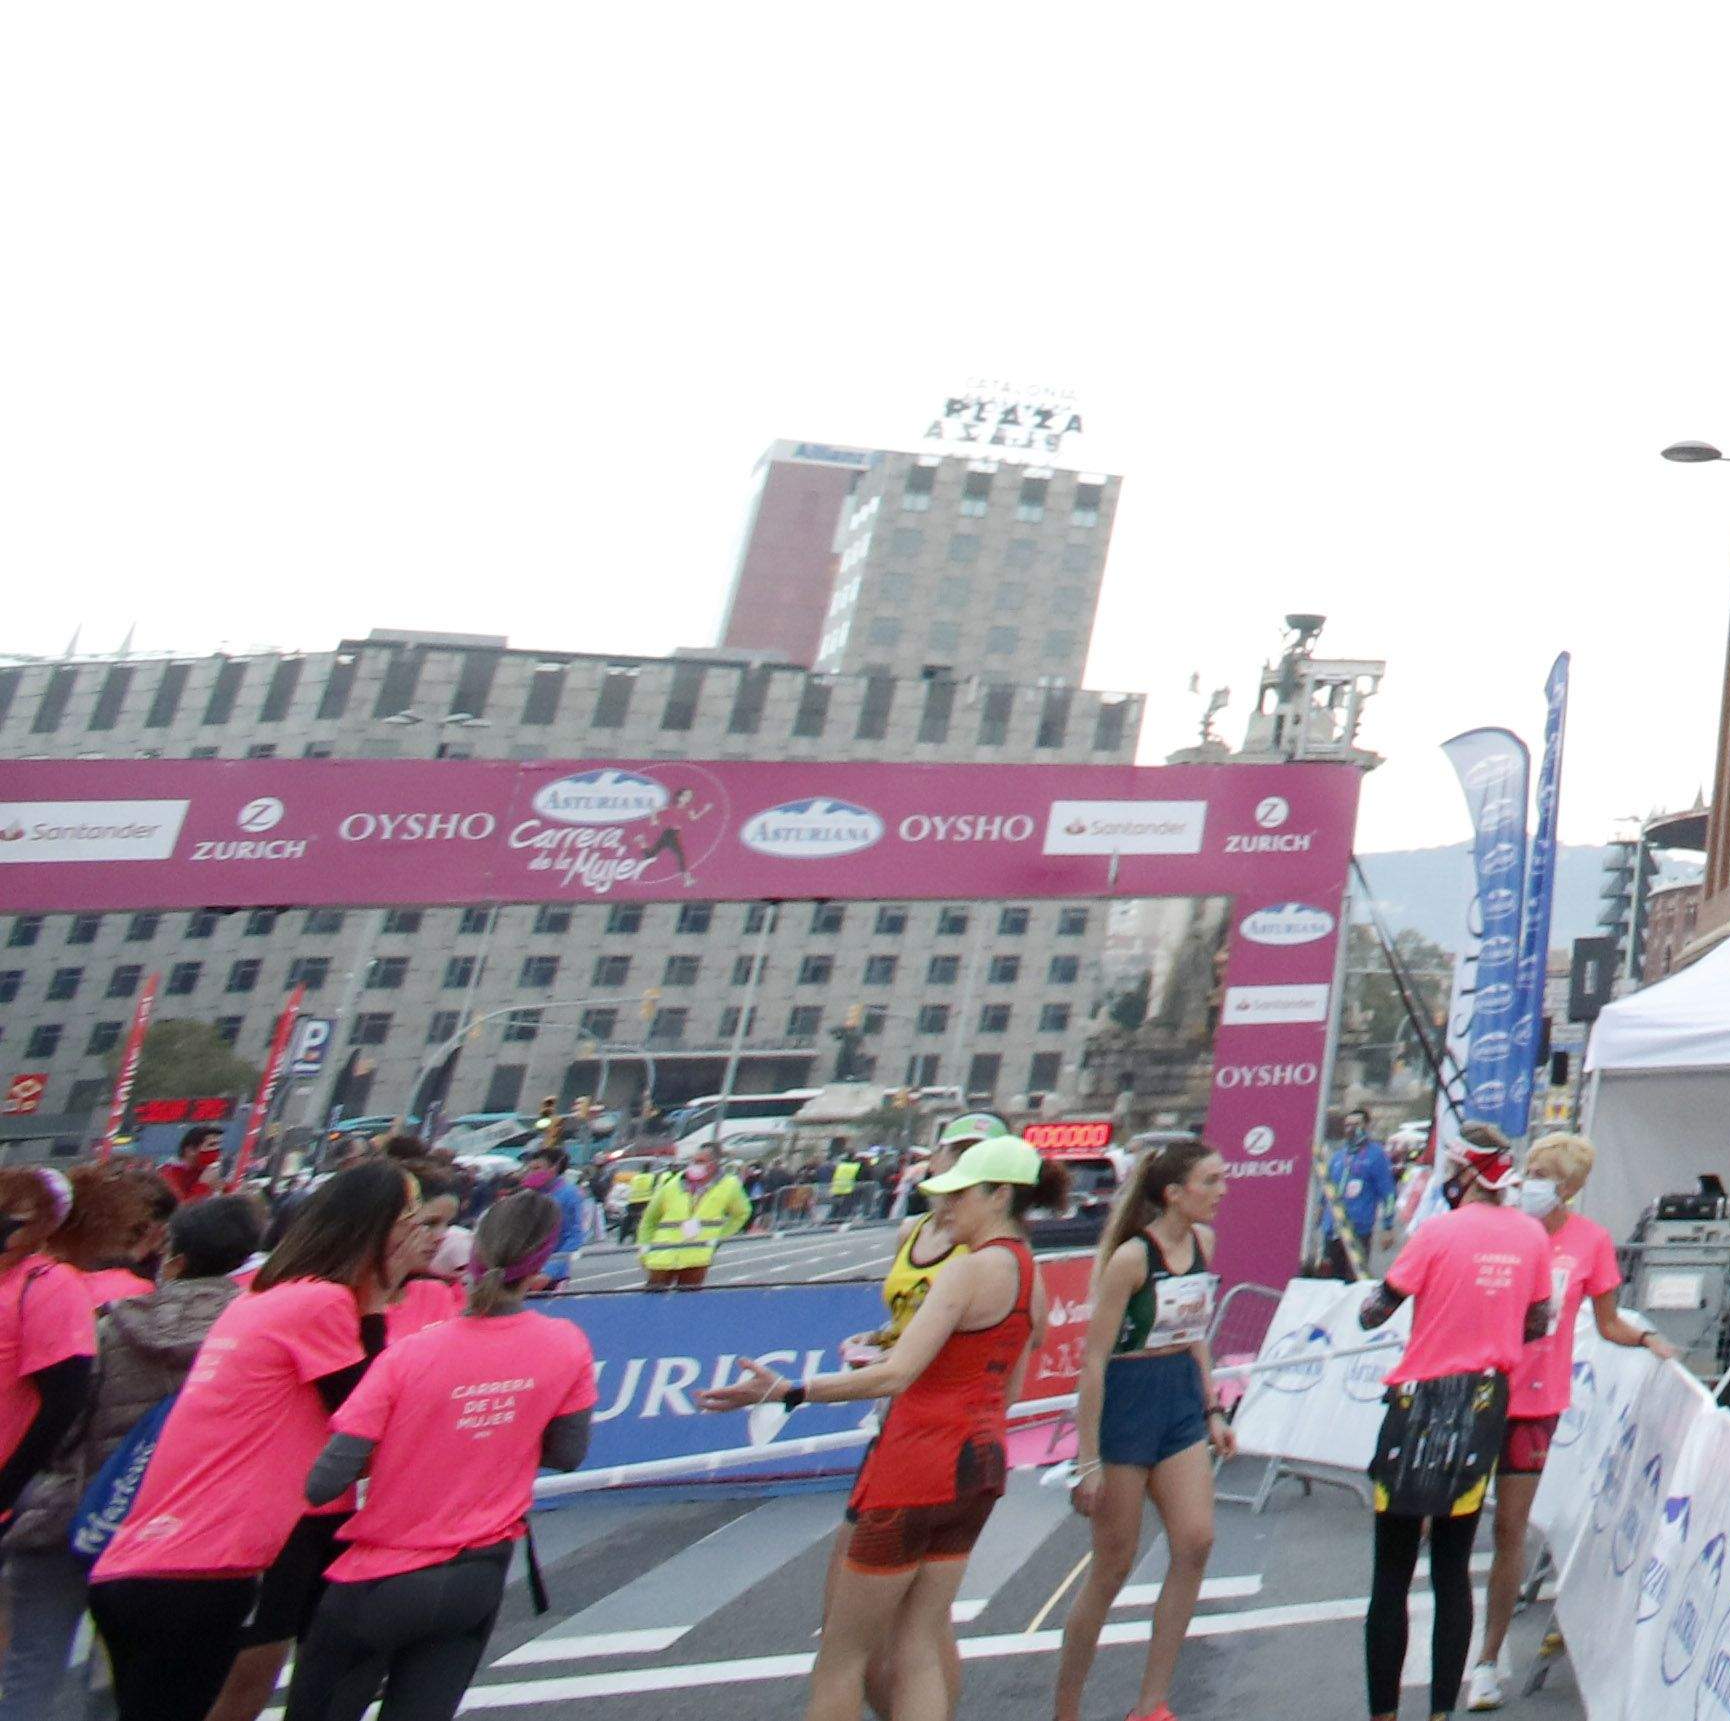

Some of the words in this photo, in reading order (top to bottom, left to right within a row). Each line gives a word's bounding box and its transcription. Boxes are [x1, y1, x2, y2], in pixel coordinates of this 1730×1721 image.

[944, 397, 1083, 433] PLAZA
[29, 822, 164, 842] Santander
[338, 812, 497, 842] OYSHO
[508, 819, 629, 855] Carrera
[899, 814, 1035, 842] OYSHO
[1089, 818, 1187, 837] Santander
[189, 839, 307, 861] ZURICH
[1224, 833, 1312, 854] ZURICH
[560, 848, 657, 894] Mujer
[1216, 1062, 1317, 1089] OYSHO
[451, 1377, 535, 1400] CARRERA
[463, 1399, 490, 1415] DE
[492, 1395, 516, 1411] LA
[455, 1410, 516, 1431] MUJER
